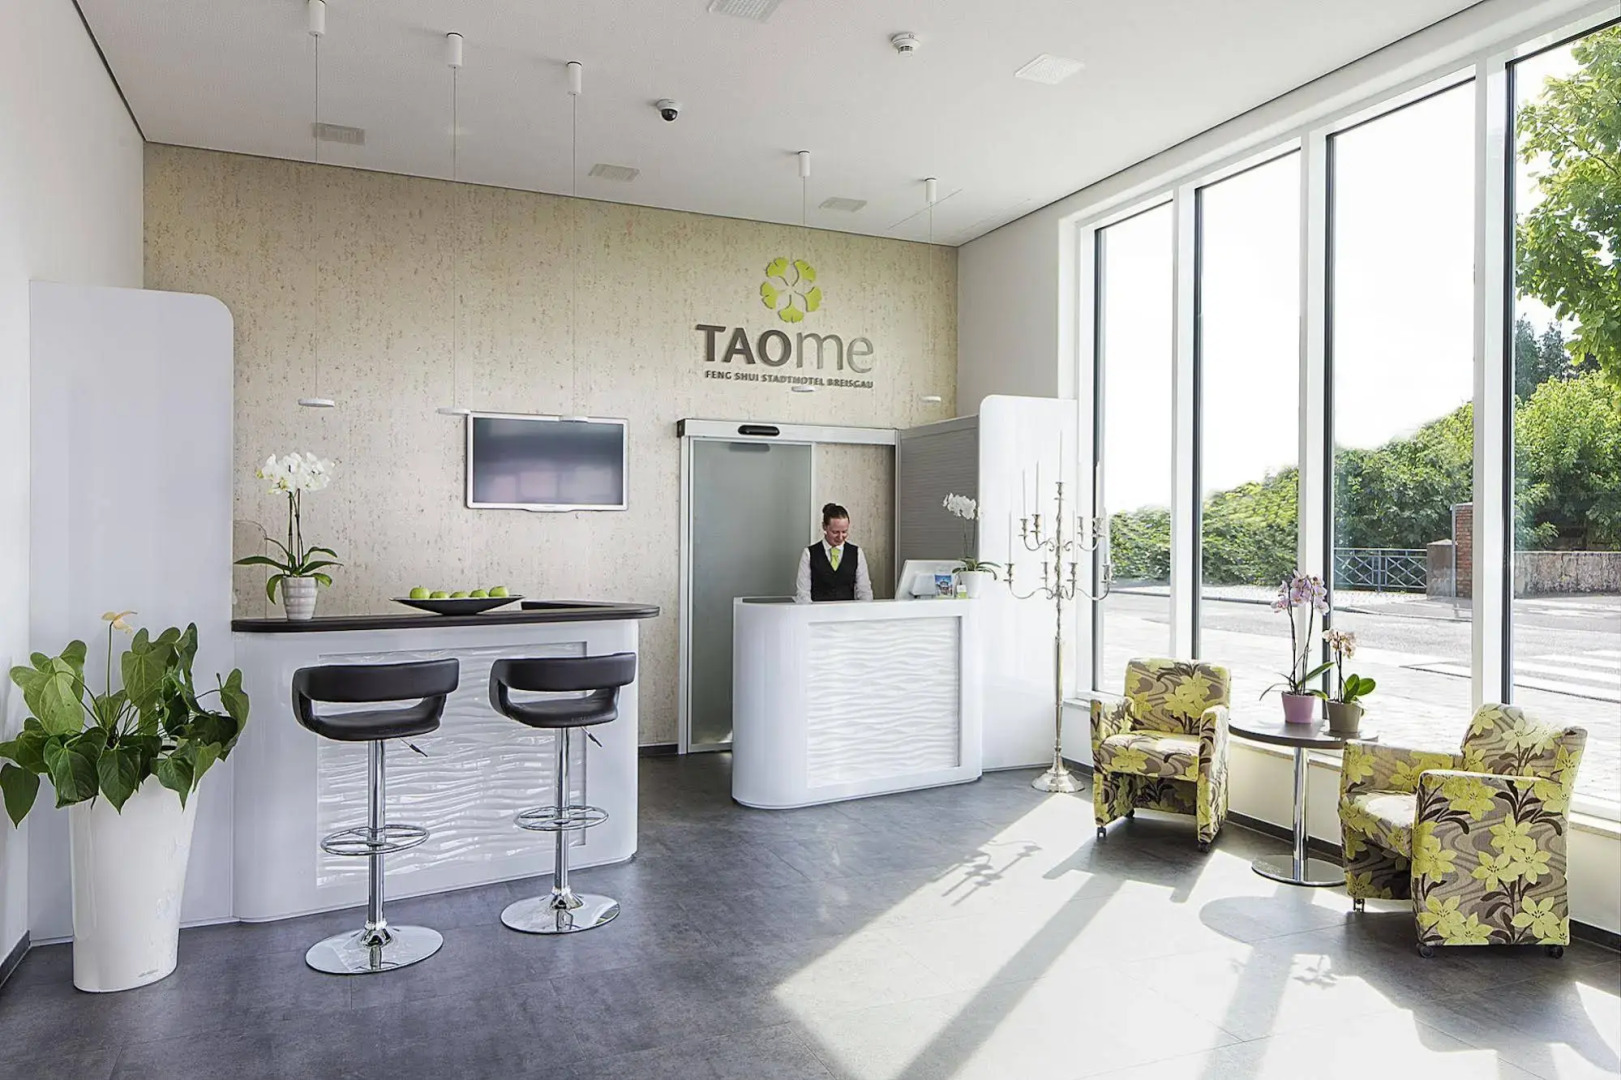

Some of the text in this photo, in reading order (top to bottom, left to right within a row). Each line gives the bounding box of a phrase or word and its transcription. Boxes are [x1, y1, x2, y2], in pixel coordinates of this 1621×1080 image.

[695, 324, 874, 374] TAOme
[705, 370, 874, 389] FENG SHUI STADTHOTEL BREISGAU
